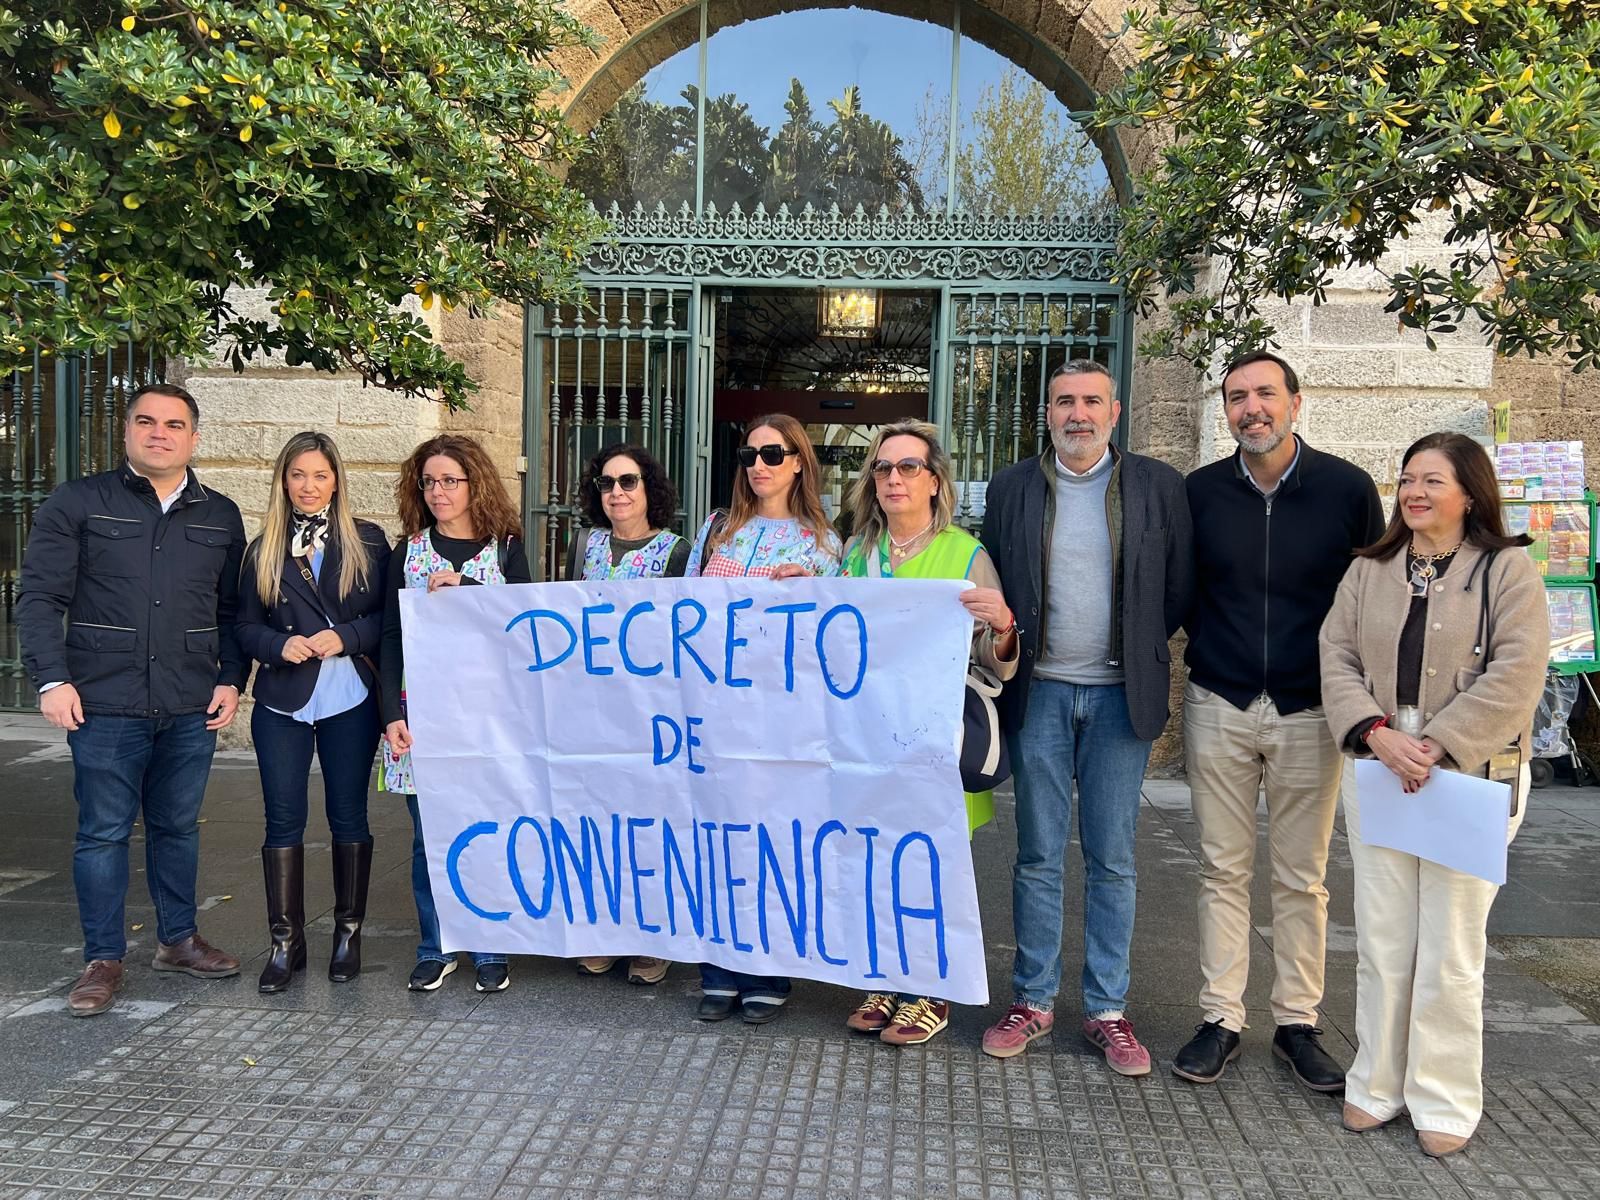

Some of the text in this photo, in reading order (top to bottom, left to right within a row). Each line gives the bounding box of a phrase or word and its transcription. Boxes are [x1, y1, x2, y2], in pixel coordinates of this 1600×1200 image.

[505, 597, 868, 700] DECRETO
[652, 715, 706, 773] DE
[446, 814, 947, 979] CONVENIENCIA
